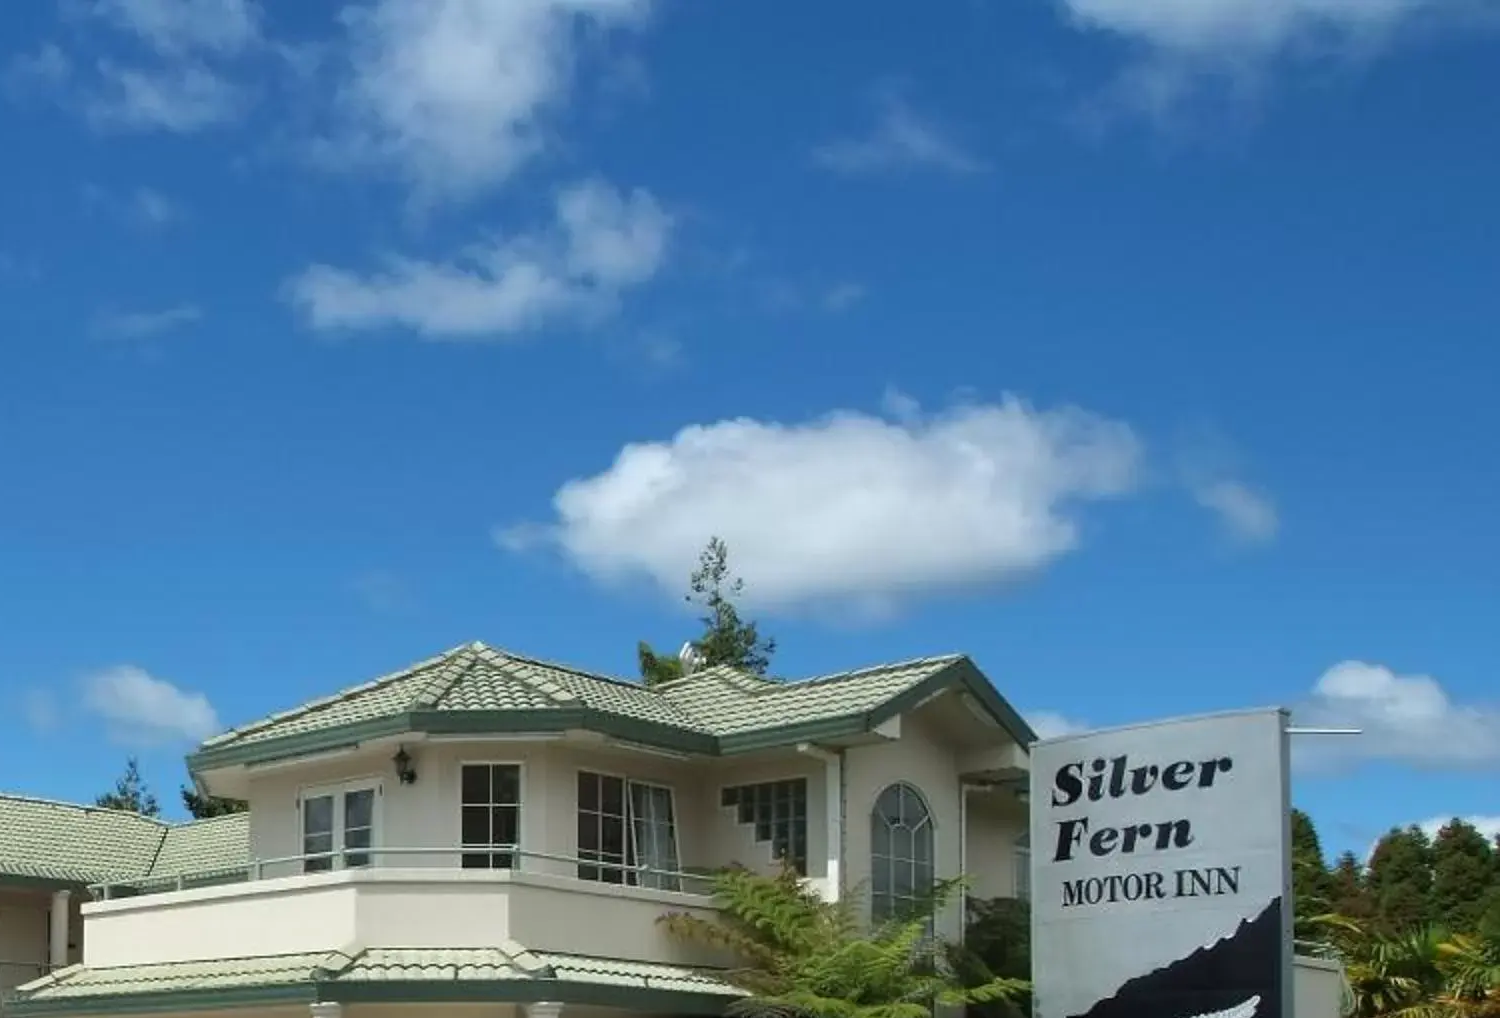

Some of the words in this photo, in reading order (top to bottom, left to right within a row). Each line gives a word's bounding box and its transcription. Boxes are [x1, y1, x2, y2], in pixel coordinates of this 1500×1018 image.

[1052, 755, 1233, 808] Silver
[1052, 817, 1196, 862] Fern
[1061, 871, 1167, 908] MOTOR
[1171, 866, 1242, 897] INN
